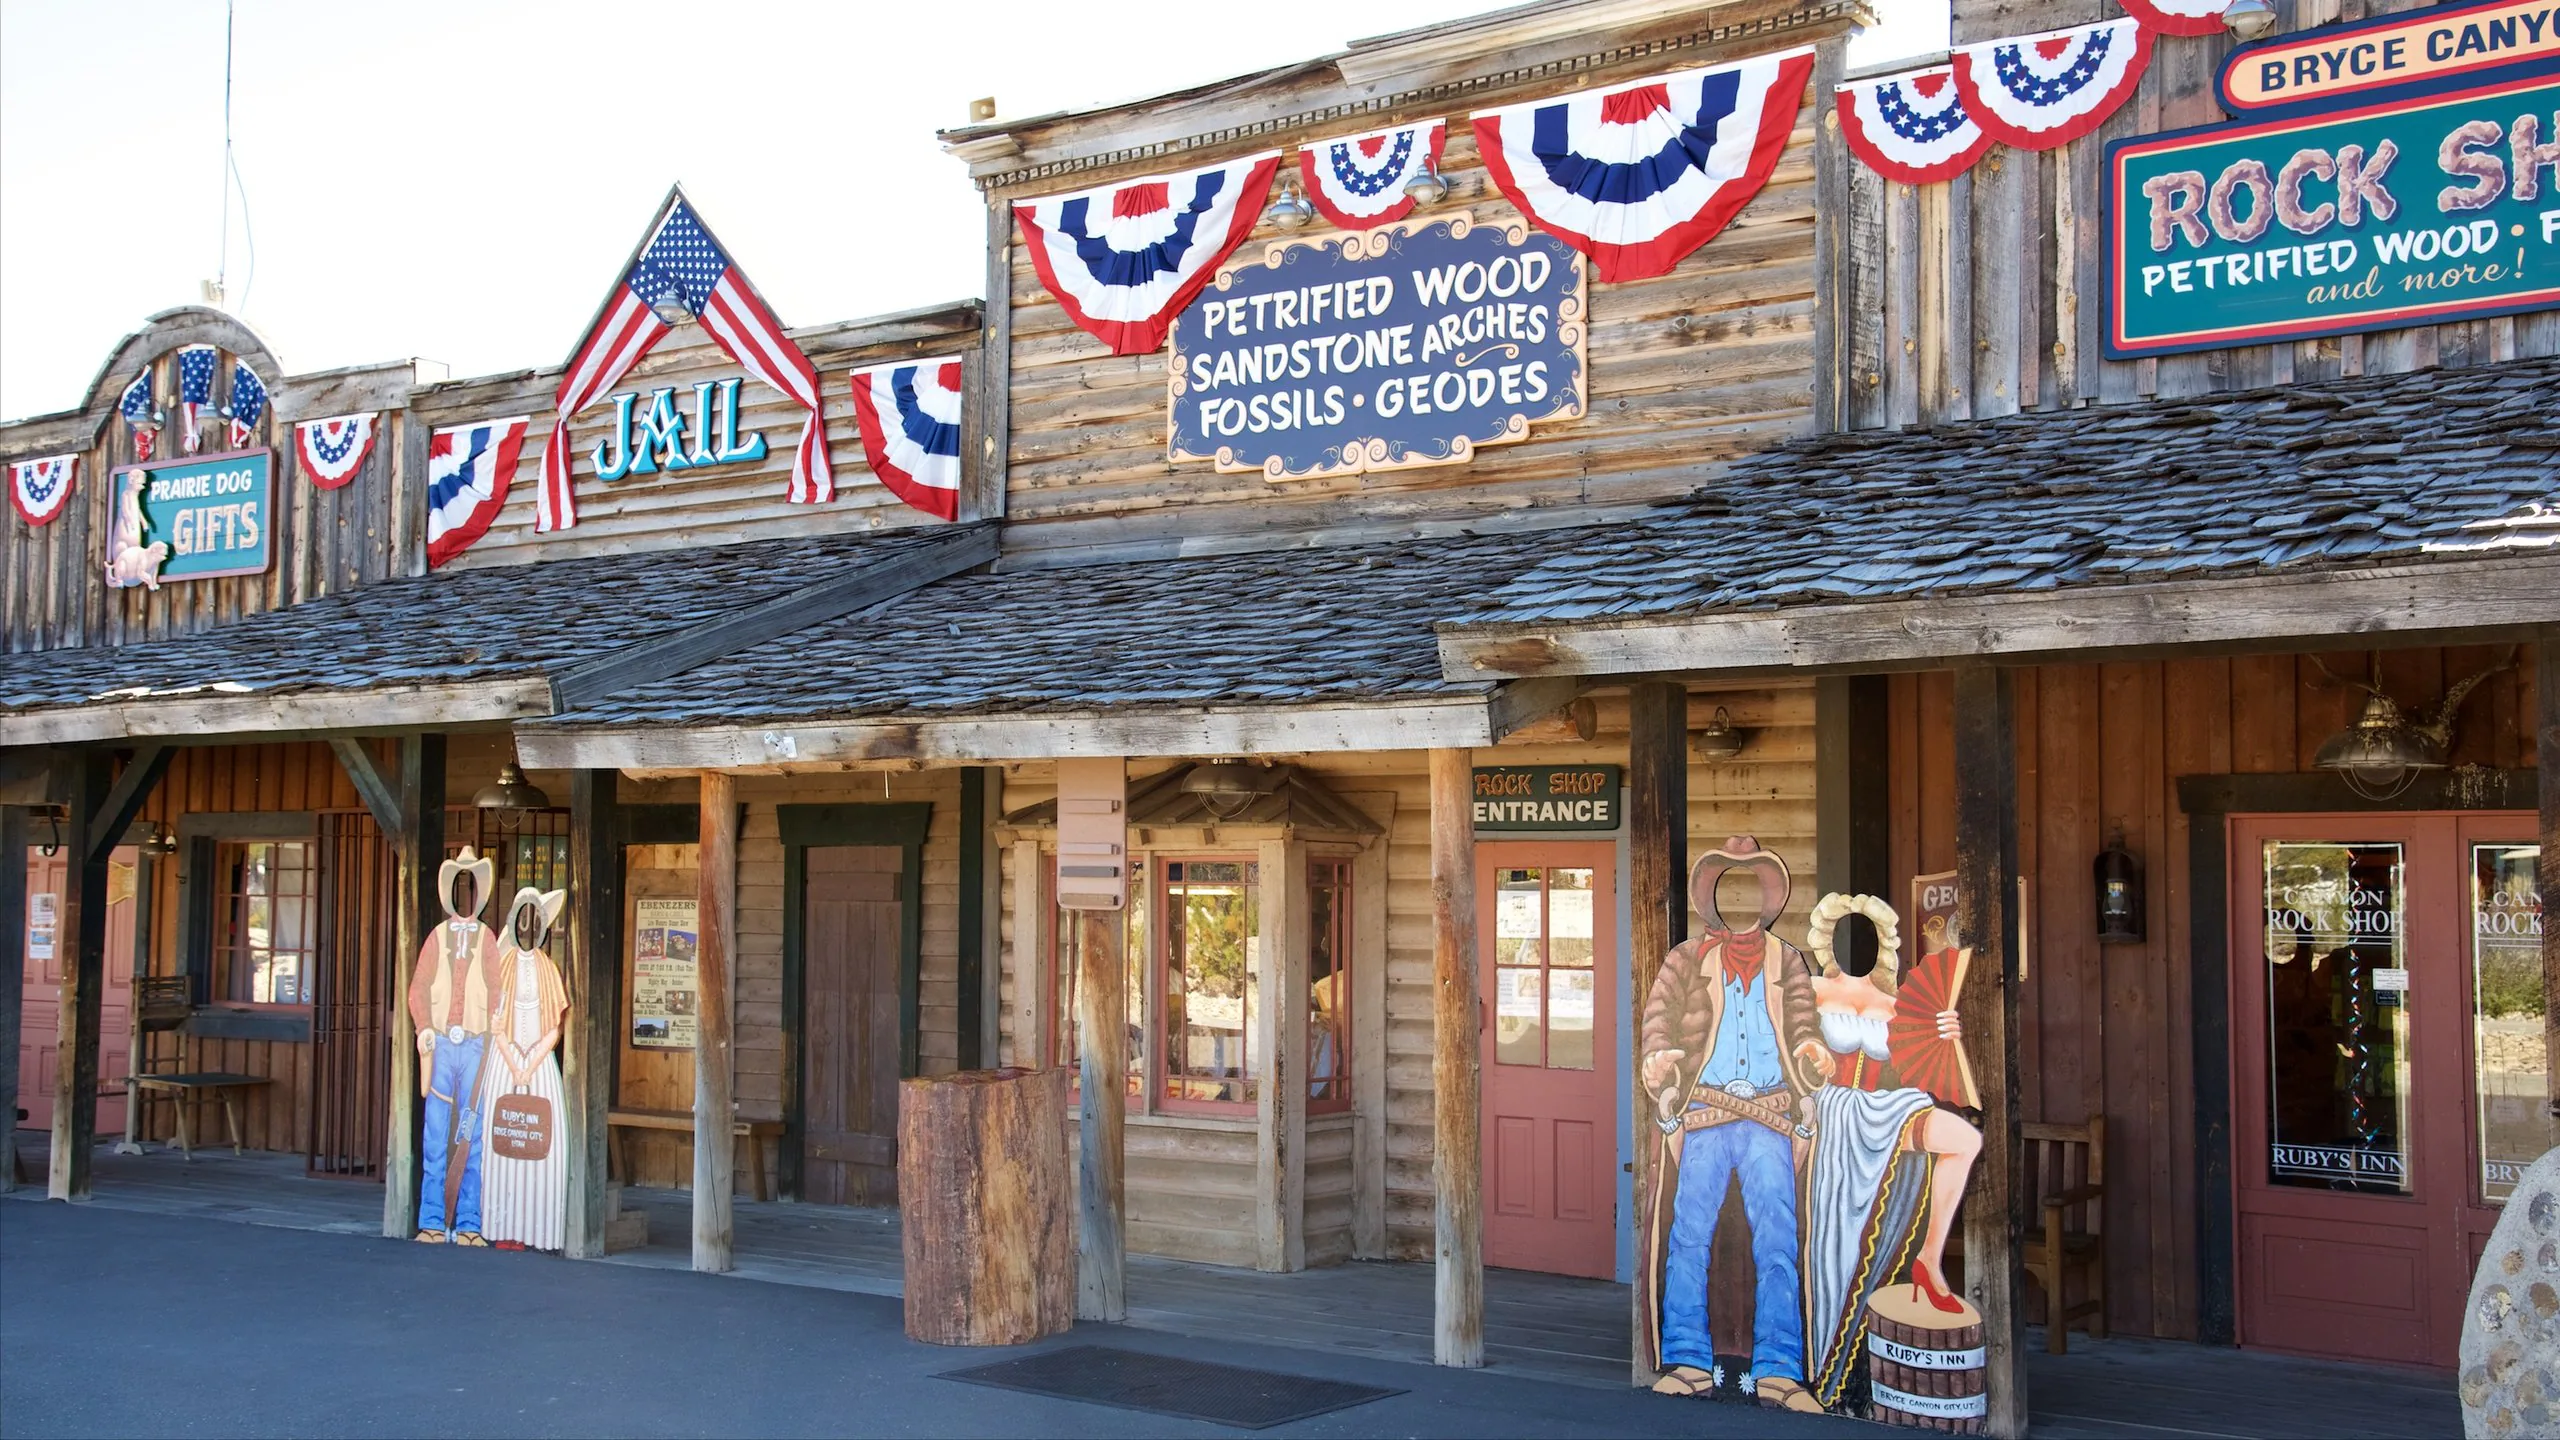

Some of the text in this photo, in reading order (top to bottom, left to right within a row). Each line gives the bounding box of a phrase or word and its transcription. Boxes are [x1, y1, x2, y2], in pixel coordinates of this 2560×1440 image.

[2260, 7, 2560, 92] BRYCE CANY
[2142, 139, 2399, 252] ROCK
[2142, 240, 2358, 297] PETRIFIED
[2374, 220, 2499, 265] WOOD
[2307, 247, 2525, 304] and more!
[1203, 251, 1551, 340] PETRIFIED WOOD
[1191, 303, 1549, 392] SANDSTONE ARCHES
[1199, 360, 1548, 438] FOSSILS GEODES
[590, 377, 768, 481] JAIL
[151, 469, 253, 501] PRAIRIE DOG
[172, 501, 259, 556] GIFTS
[1474, 772, 1606, 796] ROCK SHOP
[1473, 800, 1609, 822] ENTRANCE
[640, 901, 697, 910] EBENEZERS
[2283, 889, 2385, 906] CANYON
[2270, 910, 2402, 932] ROCK SHOP
[2478, 911, 2542, 934] ROCK
[502, 1109, 539, 1125] RUBY'S INN
[529, 1131, 543, 1142] CITY
[2272, 1147, 2405, 1174] RUBY'S INN
[1886, 1343, 1966, 1366] RUBY'S INN
[1880, 1390, 1905, 1405] BRYCE
[1909, 1399, 1940, 1410] CANYON
